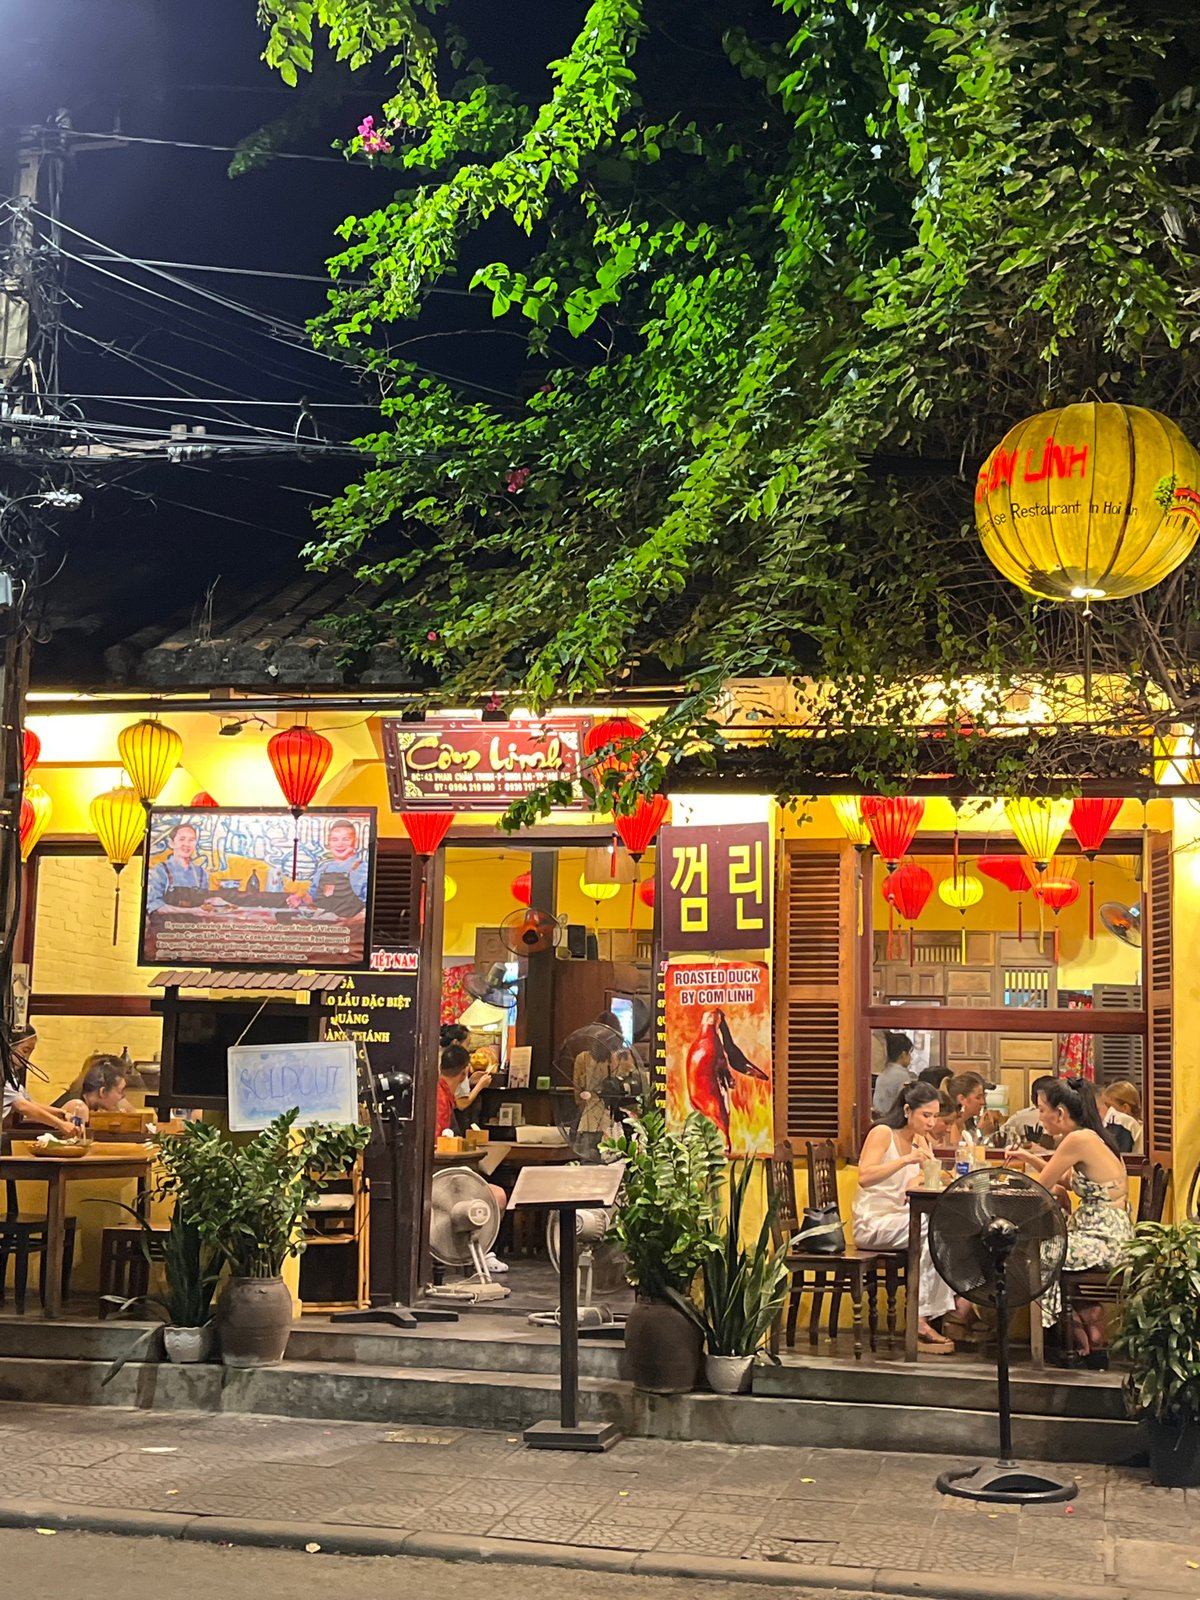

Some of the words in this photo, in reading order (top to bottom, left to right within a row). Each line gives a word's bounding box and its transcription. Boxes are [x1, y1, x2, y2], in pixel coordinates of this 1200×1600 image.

[1011, 500, 1080, 520] Restaurant
[1103, 501, 1122, 514] Hoi
[395, 952, 418, 969] NAM
[675, 970, 724, 985] ROASTED
[726, 969, 760, 984] DUCK
[386, 994, 412, 1010] BIỆT
[680, 991, 696, 1004] BY
[698, 990, 726, 1004] COM
[726, 989, 754, 1002] LINH
